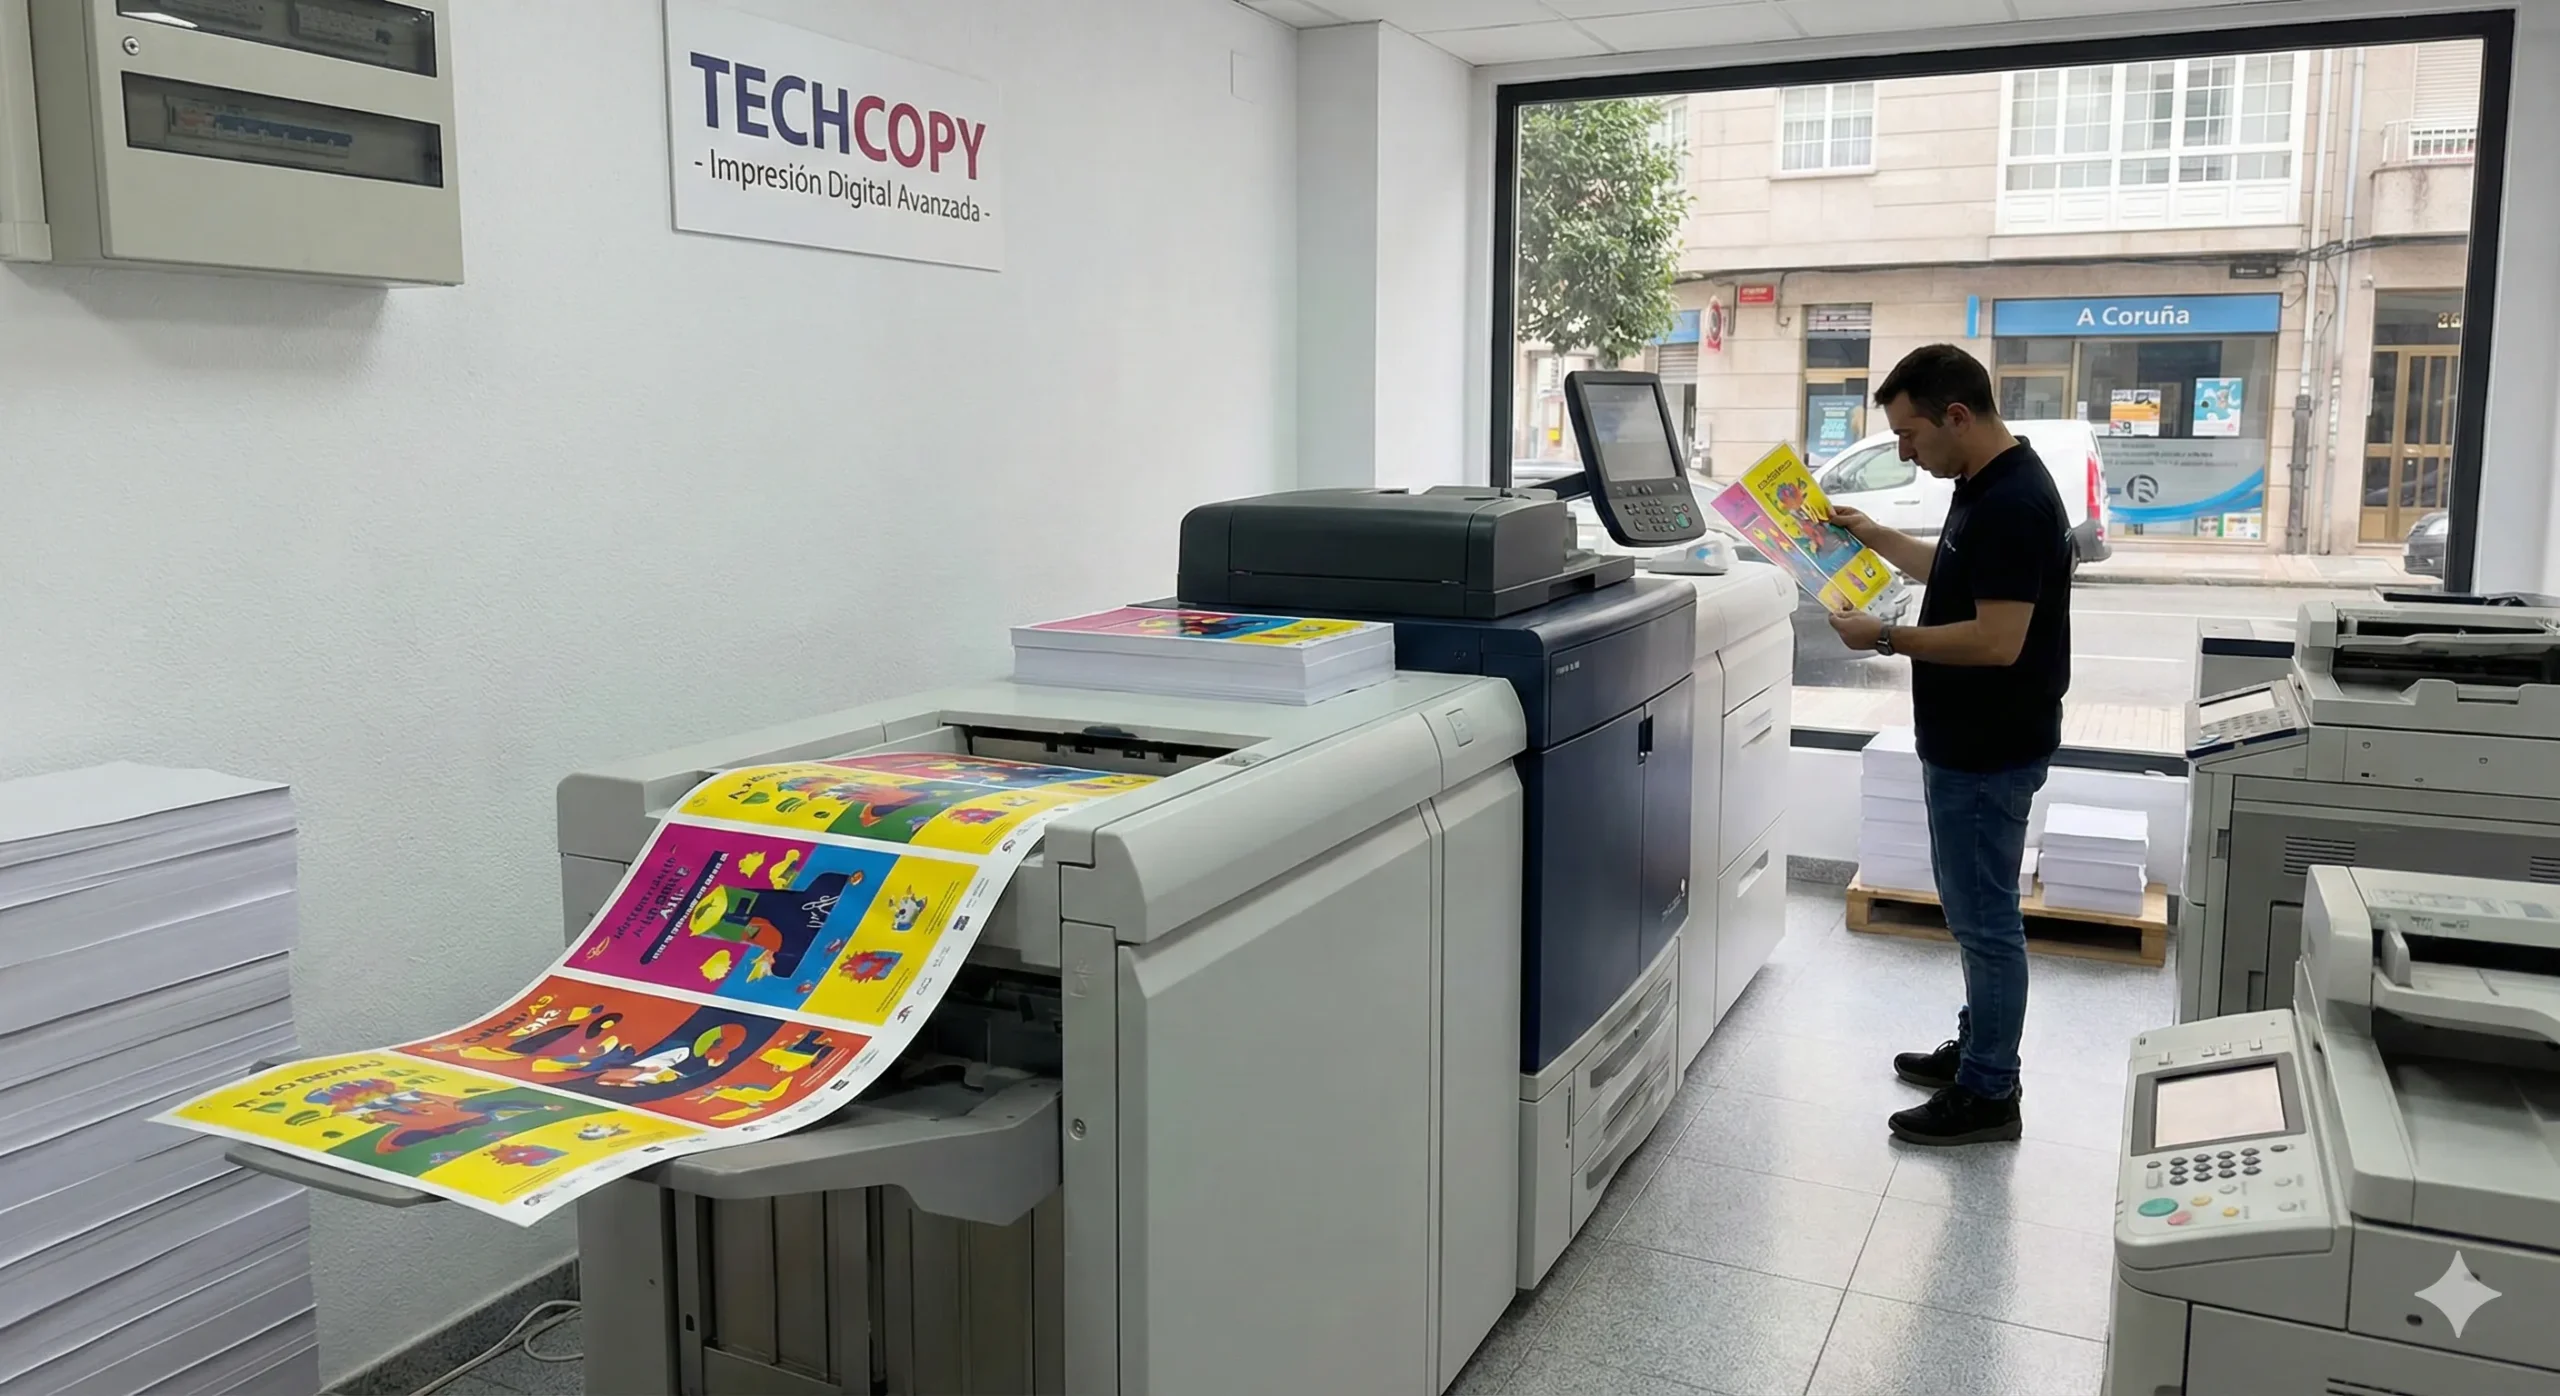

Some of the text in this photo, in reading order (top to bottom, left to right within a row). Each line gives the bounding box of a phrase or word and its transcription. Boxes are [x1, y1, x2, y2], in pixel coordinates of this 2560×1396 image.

[690, 51, 986, 180] TECHCOPY
[711, 149, 822, 195] Impresión
[828, 170, 892, 208] Digital
[897, 184, 980, 222] Avanzada
[2076, 305, 2190, 326] A Coruña
